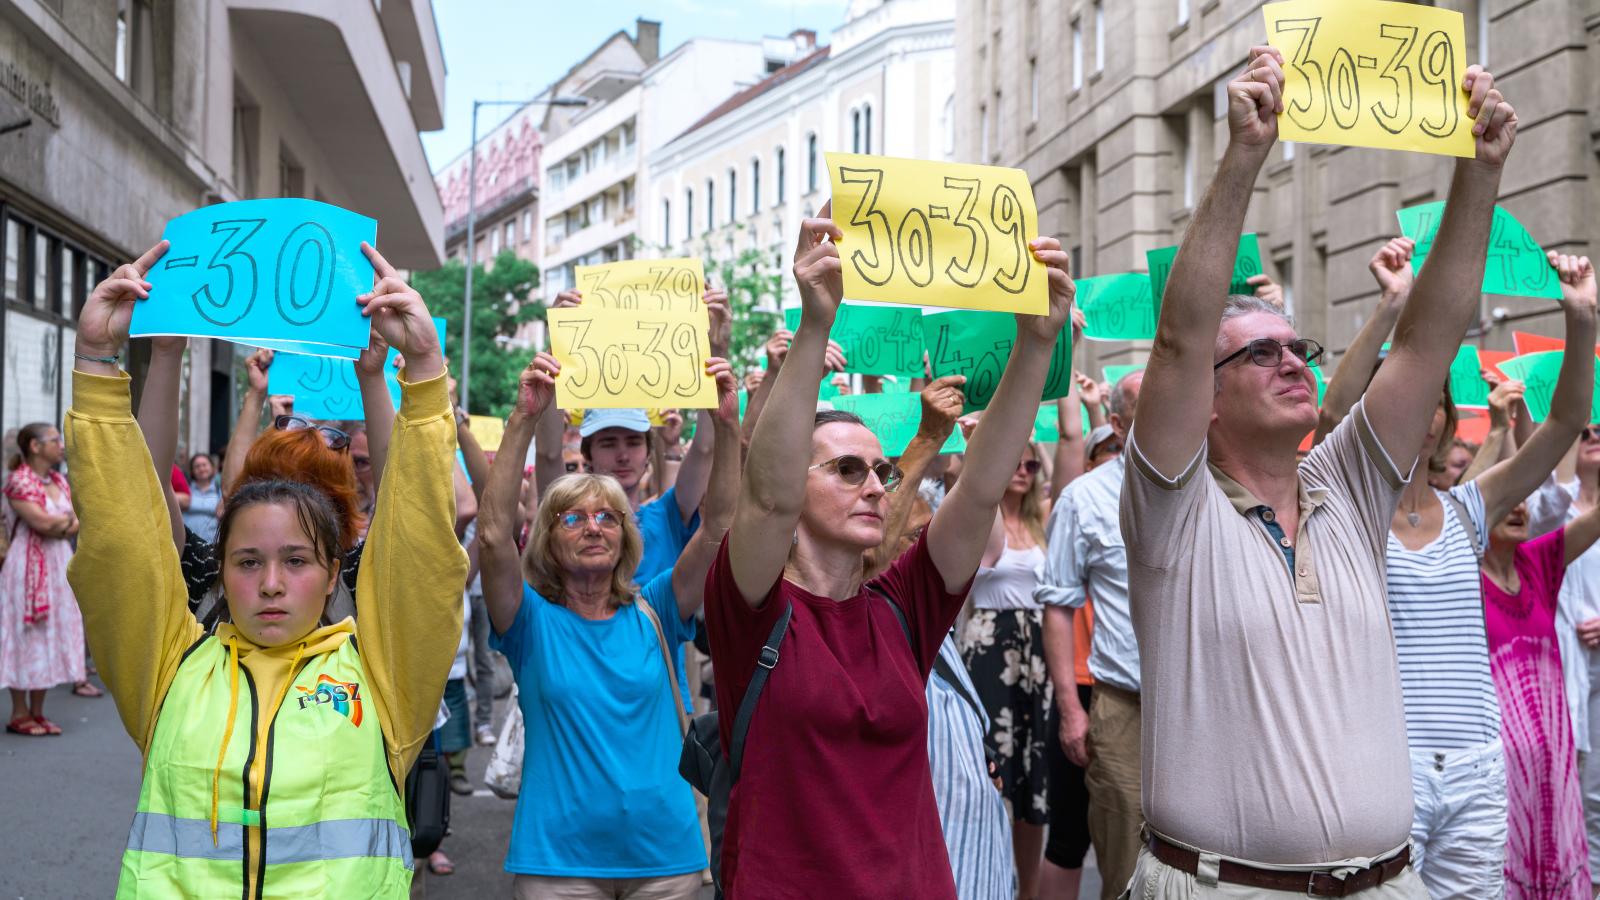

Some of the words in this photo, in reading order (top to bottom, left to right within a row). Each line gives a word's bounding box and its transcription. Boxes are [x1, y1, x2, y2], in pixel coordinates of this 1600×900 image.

[1275, 16, 1459, 139] 30-39
[165, 218, 337, 327] -30
[839, 166, 1031, 294] 30-39
[557, 318, 702, 400] 30-39
